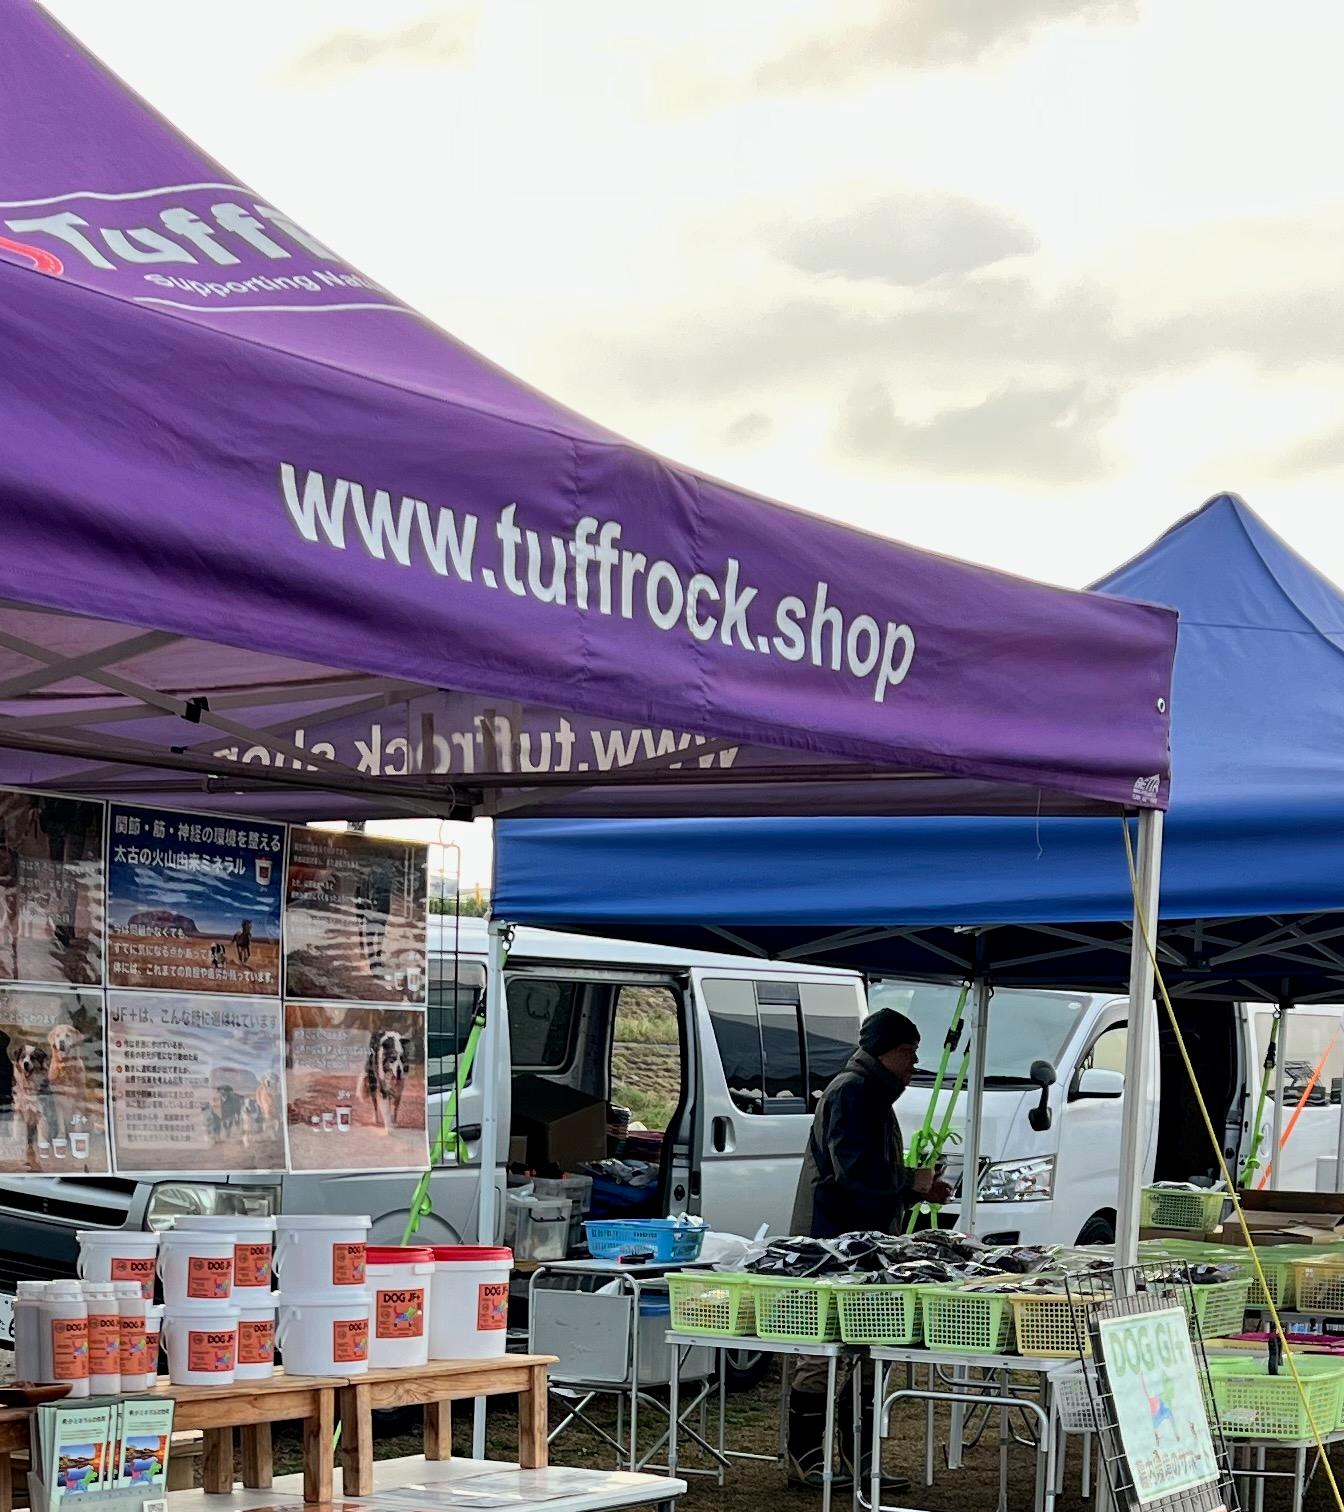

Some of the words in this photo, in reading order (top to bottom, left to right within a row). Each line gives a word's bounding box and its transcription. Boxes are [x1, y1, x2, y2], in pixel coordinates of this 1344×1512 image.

[143, 272, 322, 297] Supporting
[279, 460, 916, 703] www.tuffrock.shop
[113, 844, 246, 875] 太古の火山由来ミネラル
[383, 1293, 406, 1303] DOG
[1108, 1326, 1155, 1377] DOG
